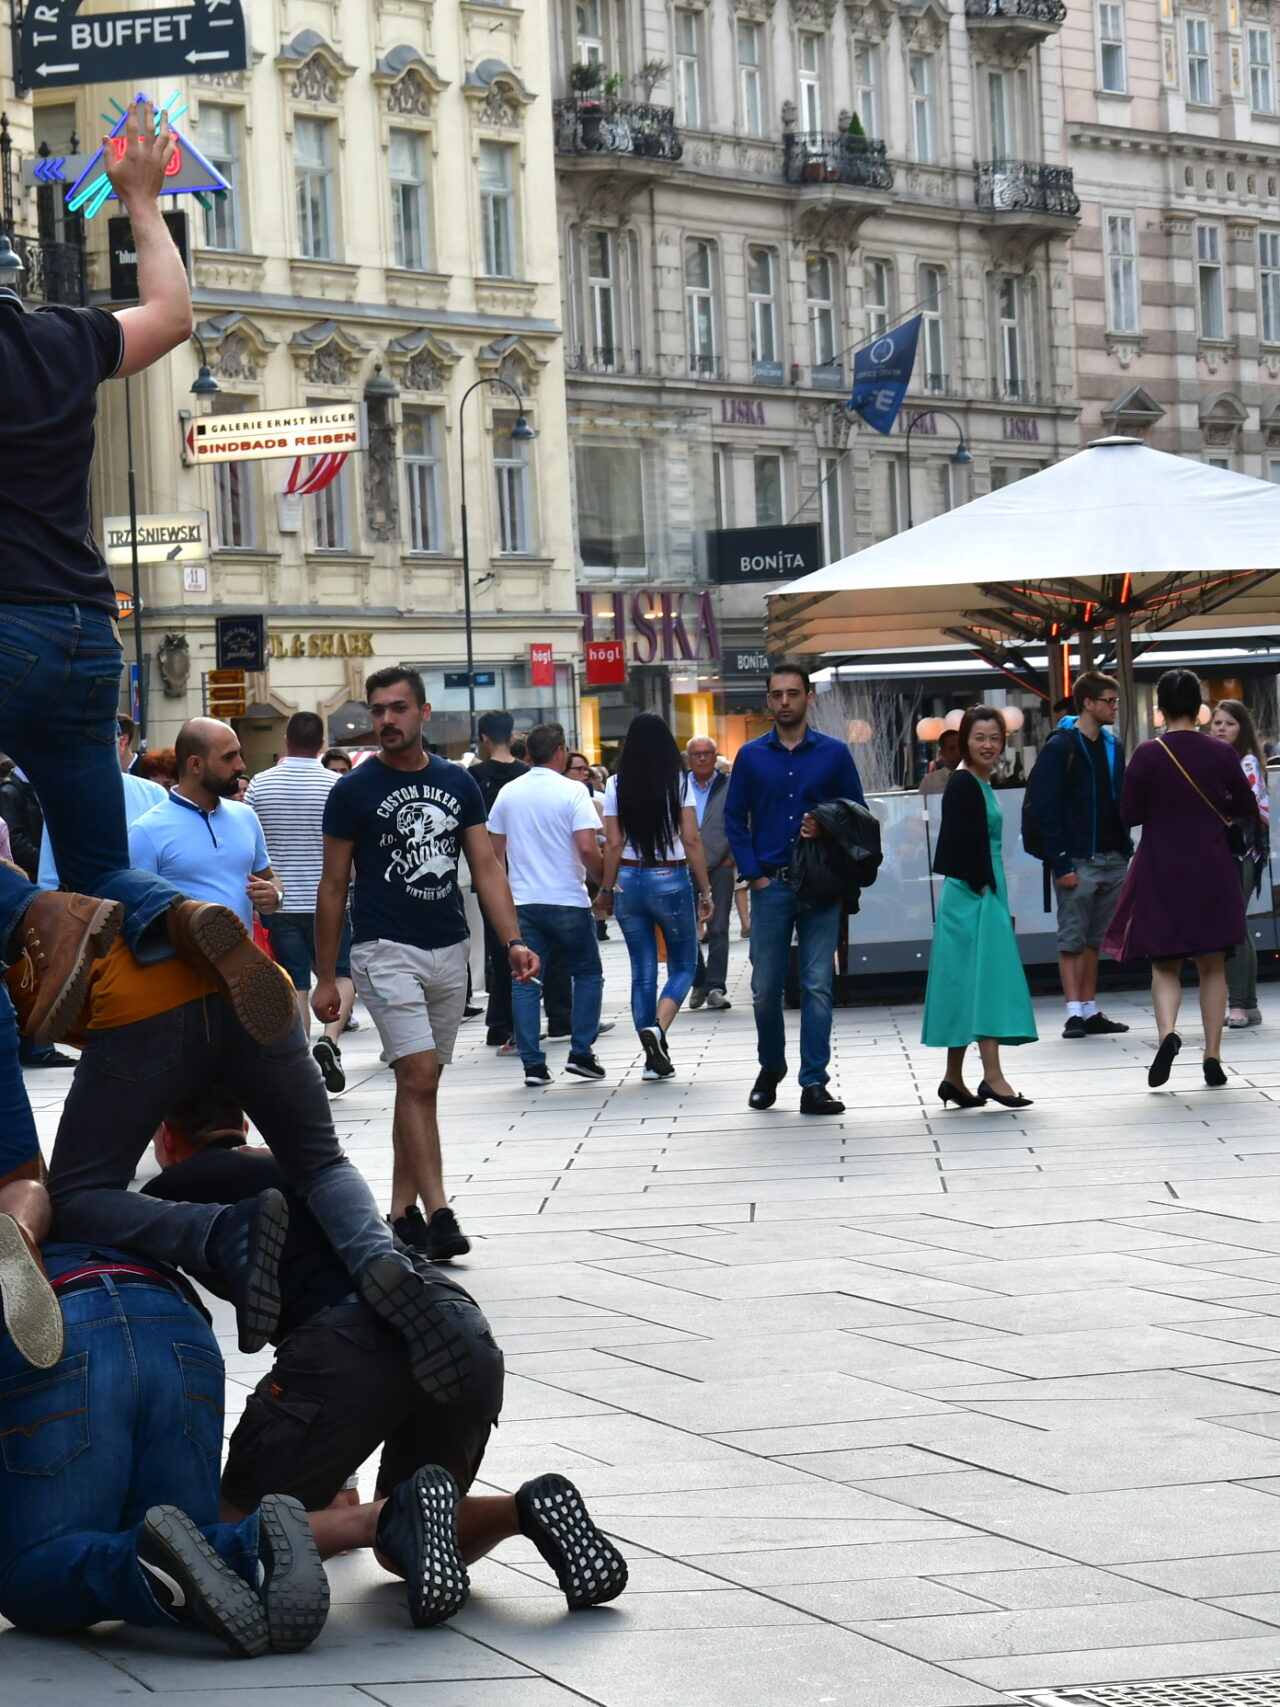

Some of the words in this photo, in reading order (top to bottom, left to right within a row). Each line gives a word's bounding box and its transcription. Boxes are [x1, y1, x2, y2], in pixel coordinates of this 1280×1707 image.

[71, 14, 192, 49] BUFFET
[211, 421, 263, 433] GALERIE
[267, 417, 305, 428] ERNST
[310, 413, 356, 425] HILGER
[108, 525, 201, 546] TRZŚNIEWSKI
[308, 632, 376, 657] SHARK
[376, 785, 420, 819] CUSTOM
[423, 785, 461, 815] BIKERS
